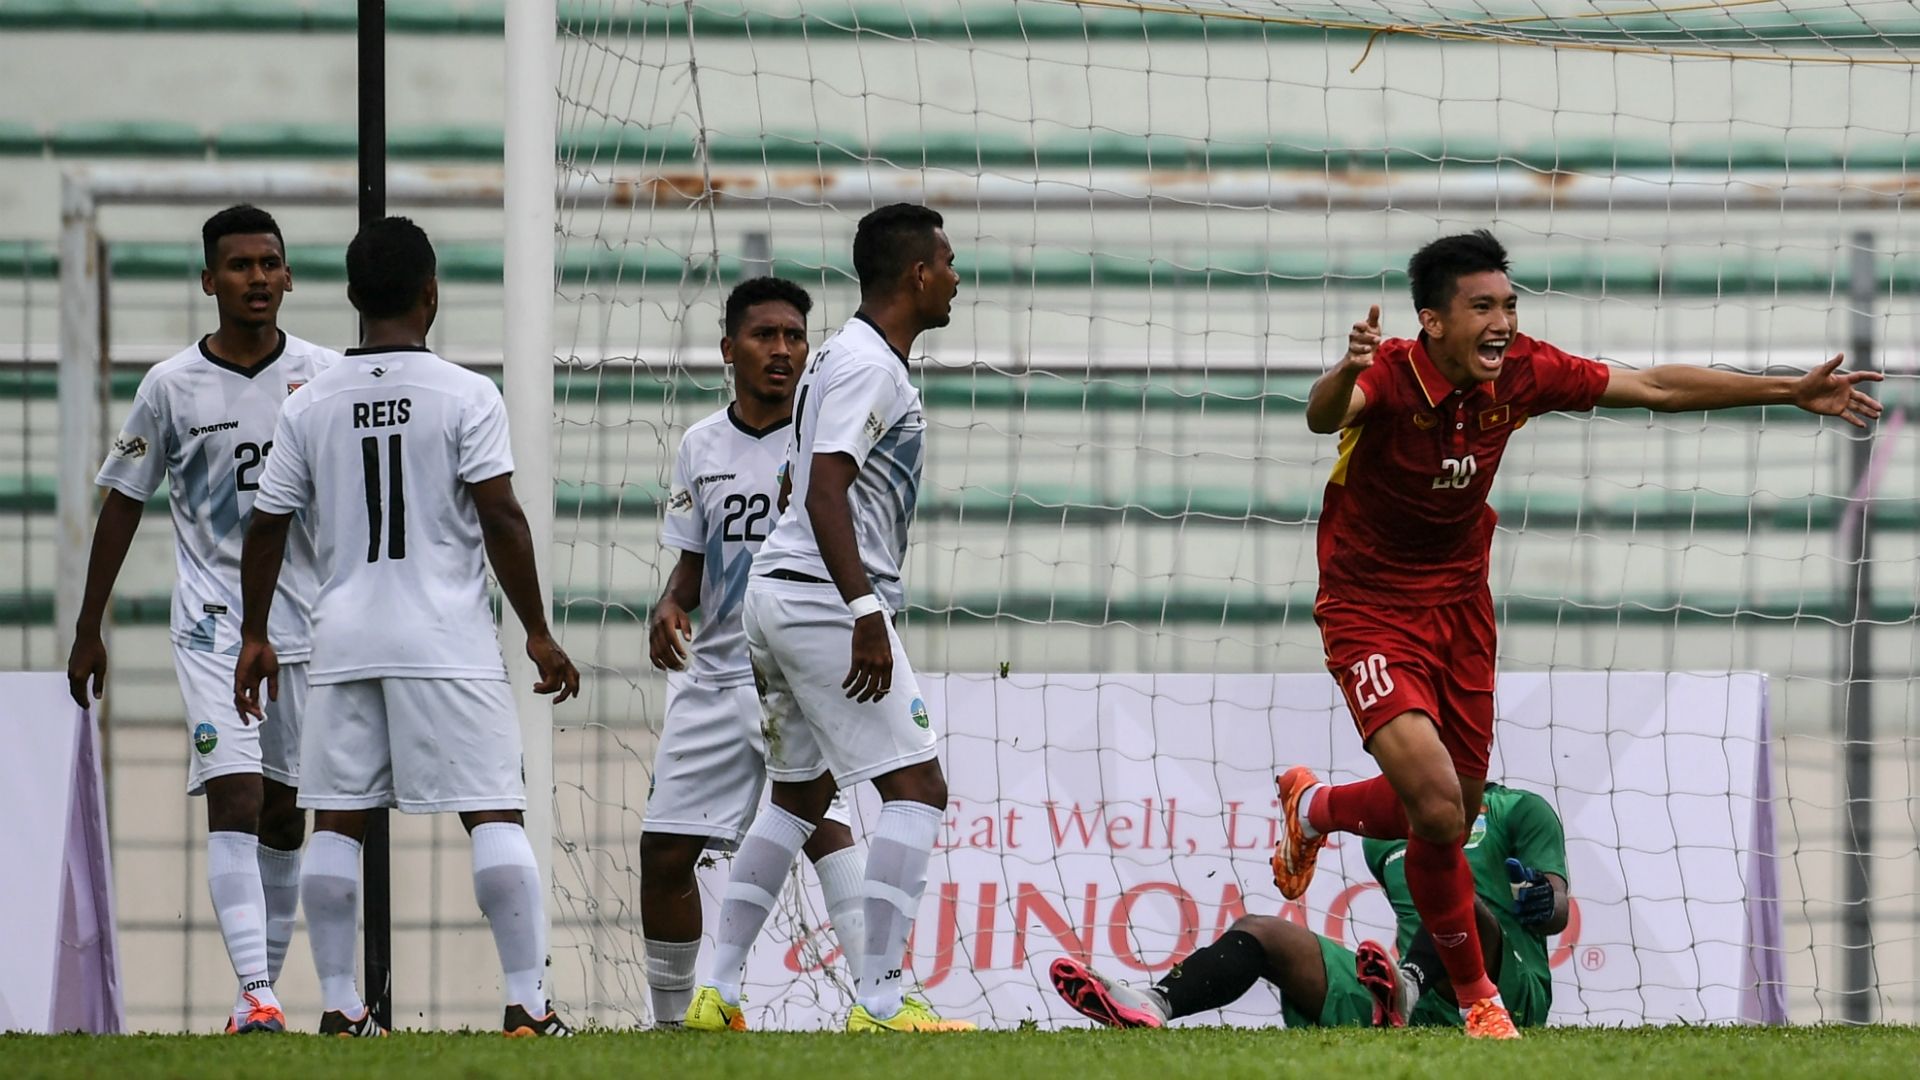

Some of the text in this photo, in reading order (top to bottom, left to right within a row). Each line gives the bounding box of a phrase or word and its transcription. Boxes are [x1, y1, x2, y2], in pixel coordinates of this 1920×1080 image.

[200, 421, 239, 434] narrow
[353, 398, 412, 428] REIS
[704, 474, 736, 485] narrow
[1431, 454, 1477, 490] 20
[361, 434, 406, 563] 11
[723, 493, 771, 542] 22
[1350, 653, 1395, 711] 20
[932, 800, 1023, 849] Eat
[1041, 797, 1197, 855] Well,
